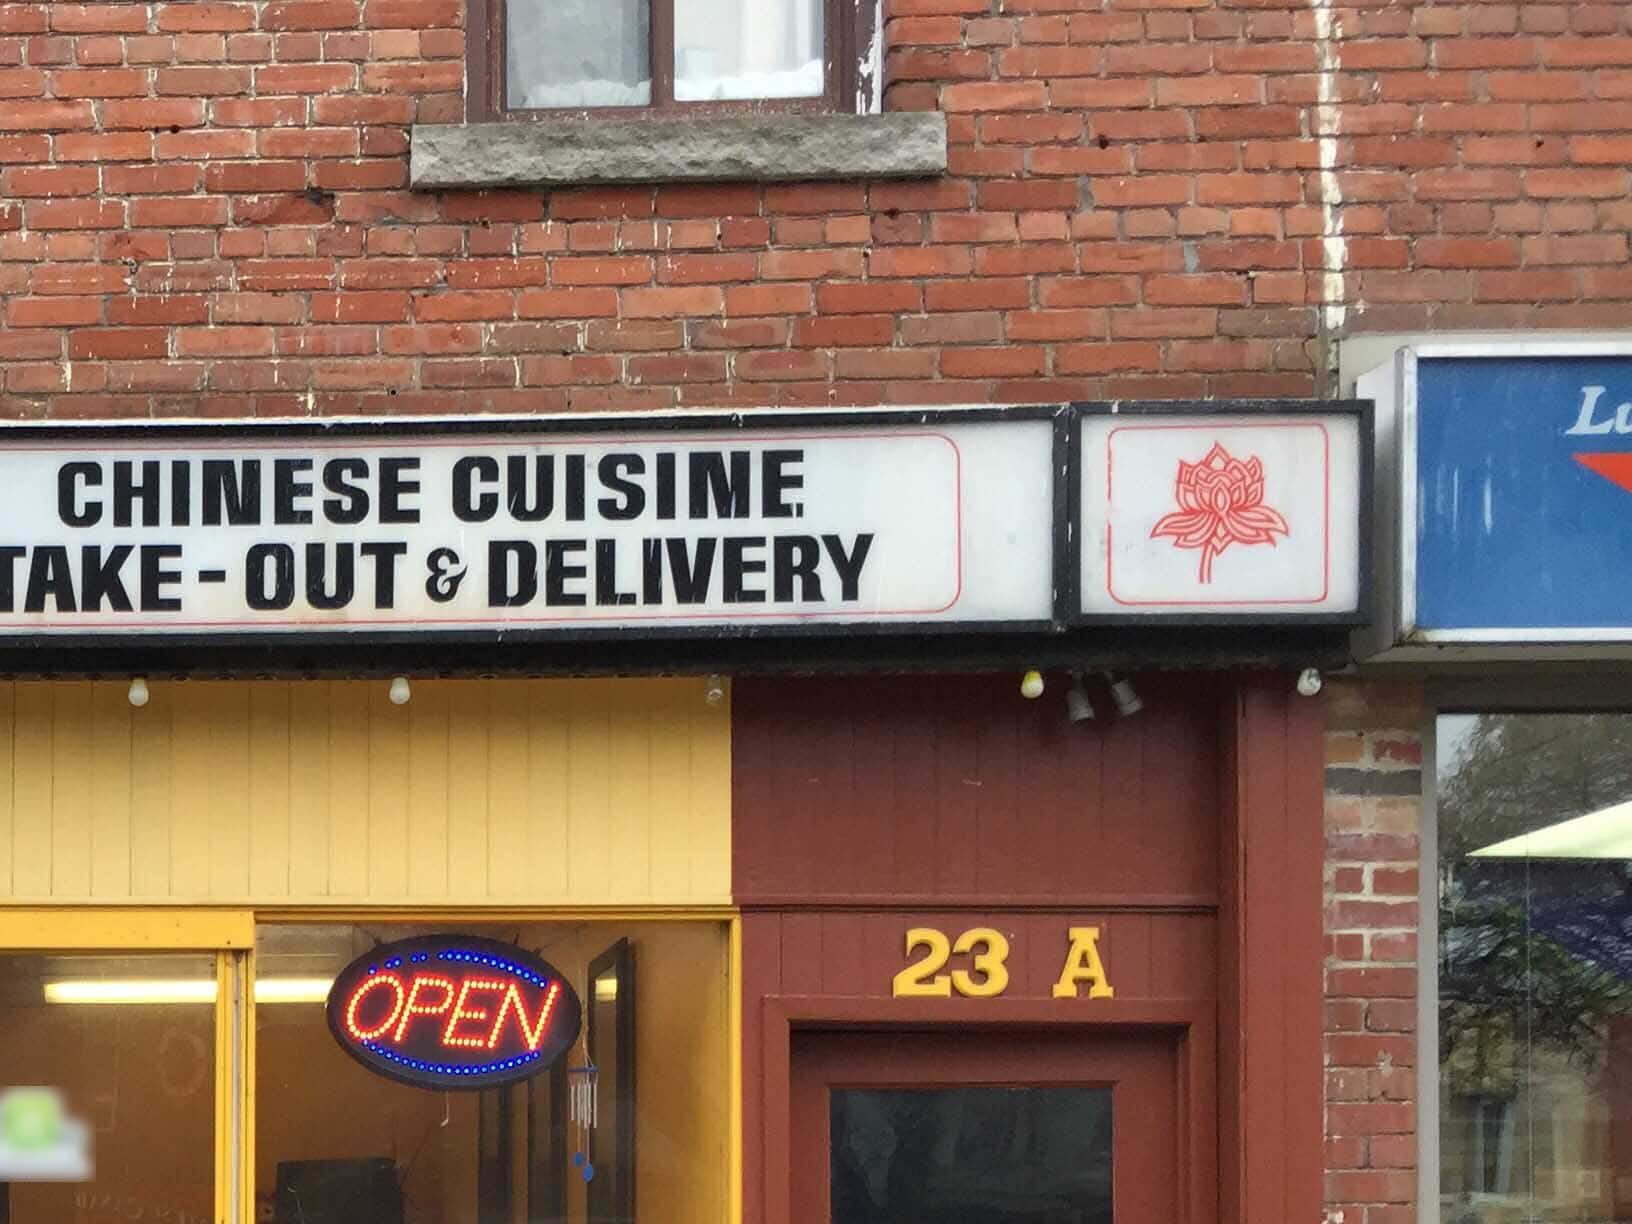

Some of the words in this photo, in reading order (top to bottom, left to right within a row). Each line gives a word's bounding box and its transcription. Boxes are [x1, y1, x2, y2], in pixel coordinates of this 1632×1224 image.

[58, 457, 421, 527] CHINESE
[452, 449, 805, 522] CUISINE
[424, 547, 468, 603] &
[488, 534, 875, 607] DELIVERY
[892, 927, 1010, 998] 23
[1051, 926, 1115, 999] A
[344, 972, 561, 1051] OPEN
